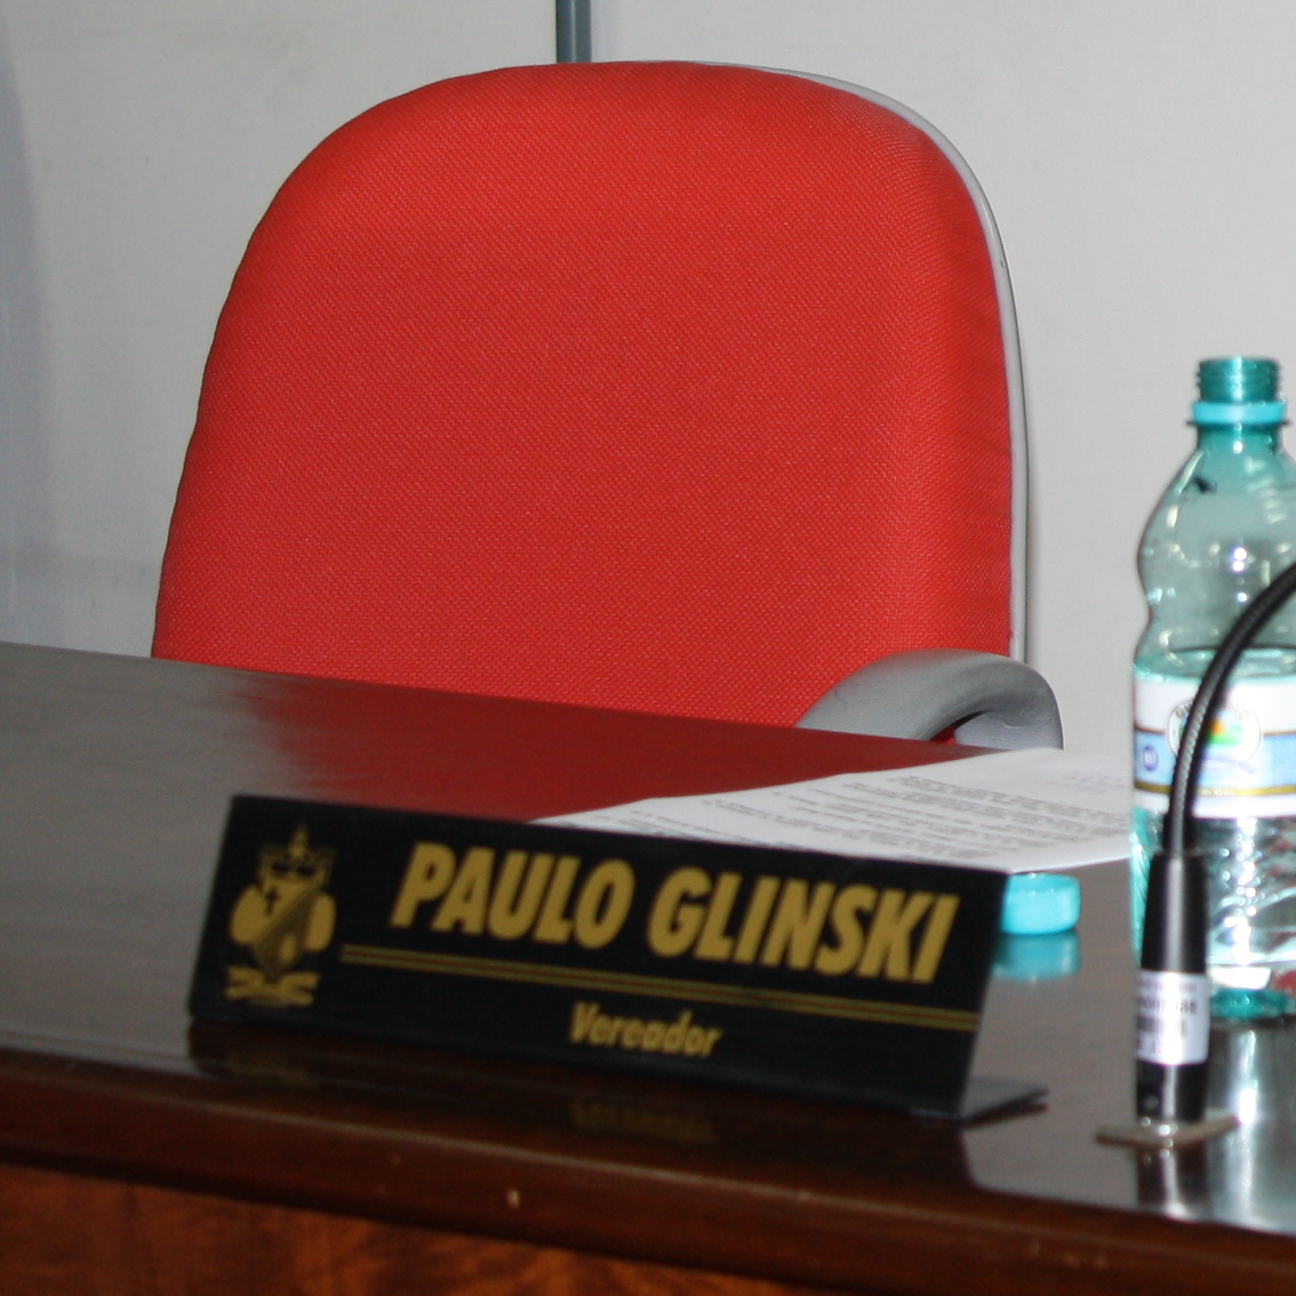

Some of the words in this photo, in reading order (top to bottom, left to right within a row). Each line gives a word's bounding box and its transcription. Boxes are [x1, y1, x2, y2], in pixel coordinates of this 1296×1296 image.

[390, 840, 636, 950] PAULO
[646, 865, 960, 984] GLINSKI
[570, 1001, 723, 1058] Vereador
